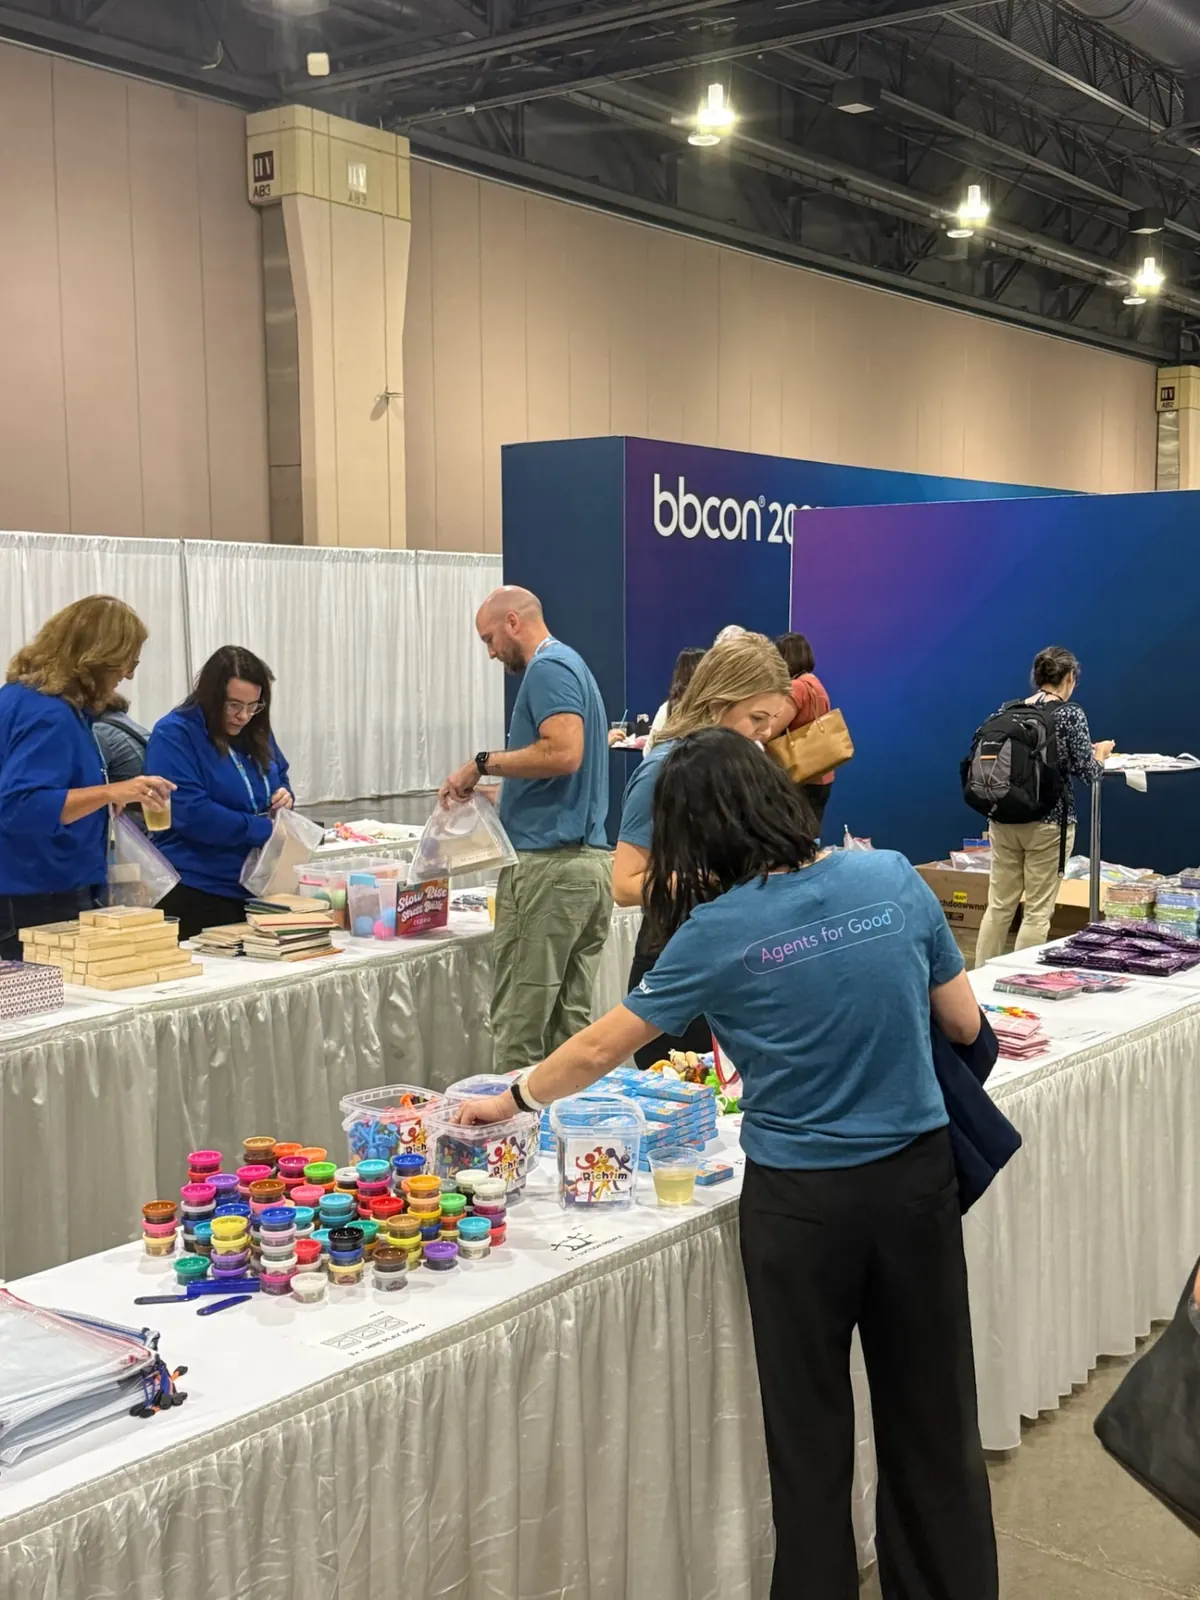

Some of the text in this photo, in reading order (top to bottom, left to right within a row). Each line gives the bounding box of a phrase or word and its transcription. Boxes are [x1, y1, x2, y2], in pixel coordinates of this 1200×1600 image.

[253, 184, 271, 198] AB3
[397, 892, 424, 912] Slow
[760, 934, 819, 964] Agents
[820, 926, 844, 943] for
[582, 1167, 628, 1182] Richtim
